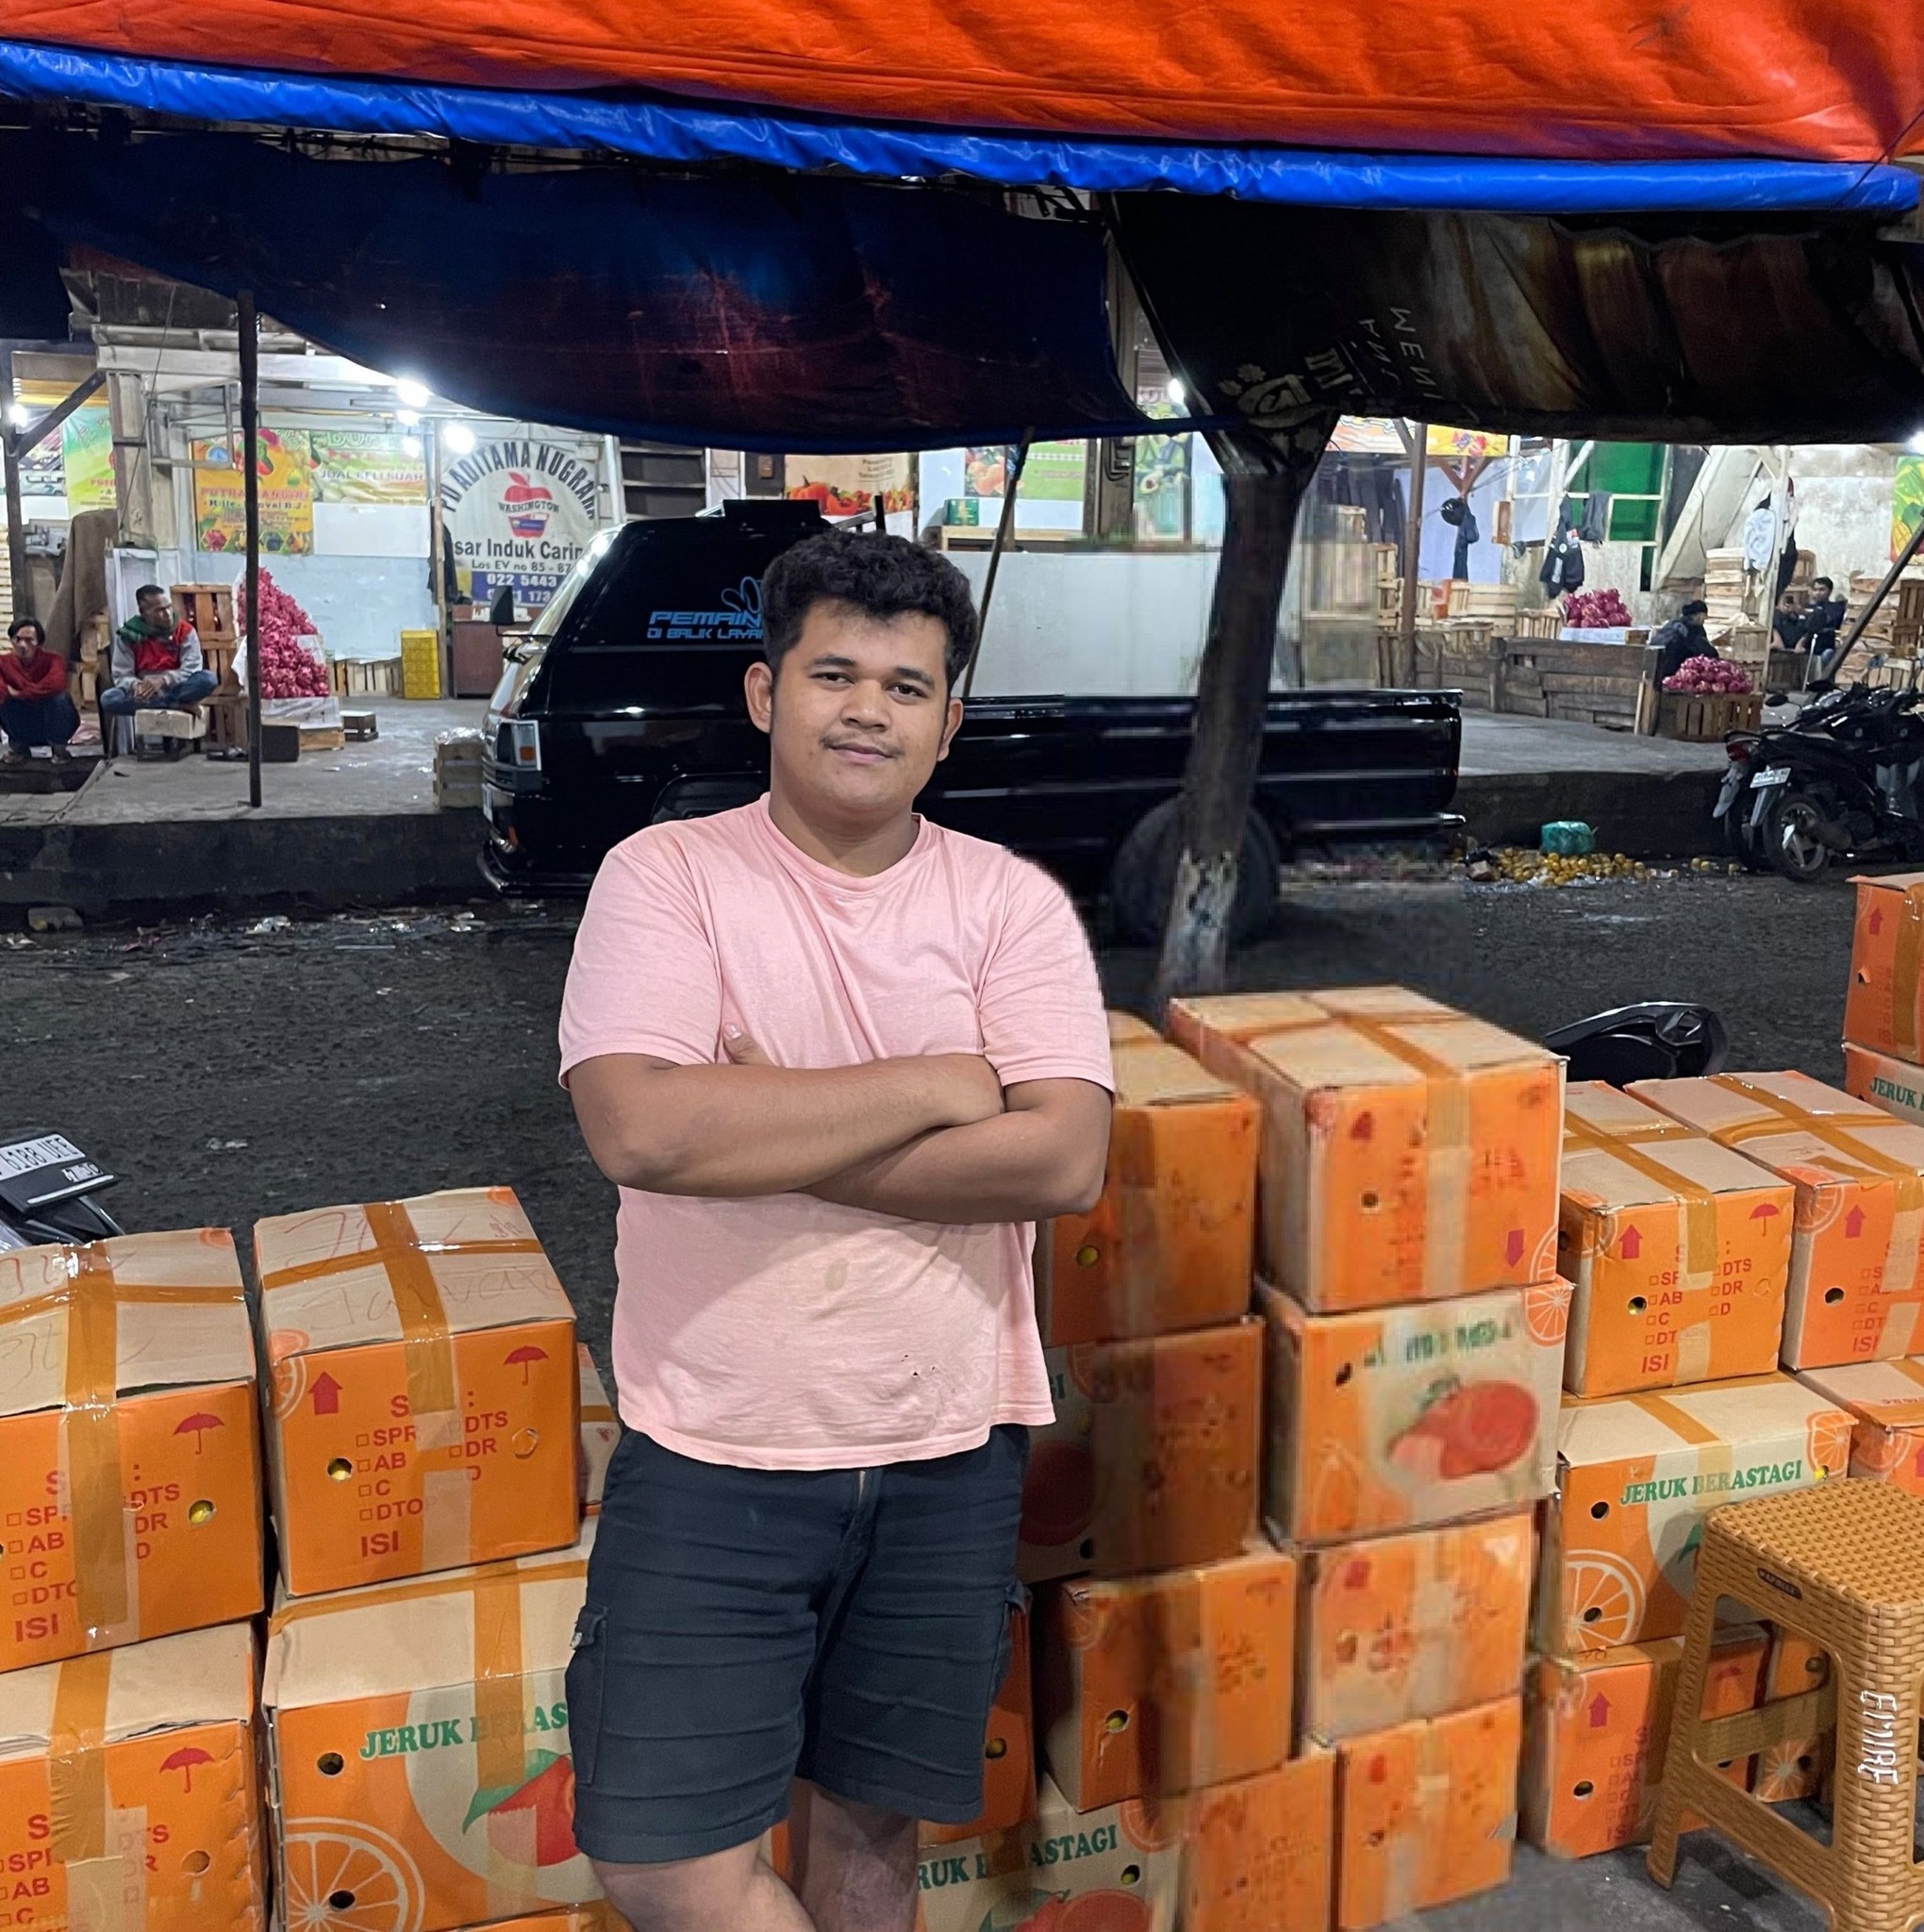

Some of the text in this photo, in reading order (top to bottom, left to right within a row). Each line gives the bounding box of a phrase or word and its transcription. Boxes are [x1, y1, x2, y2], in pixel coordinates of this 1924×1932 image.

[448, 441, 532, 491] ADITAMA
[498, 500, 560, 513] WASHINGTON
[455, 539, 584, 560] sar Induk Carin
[472, 558, 490, 570] Los
[495, 560, 510, 570] EV
[514, 563, 527, 572] no
[531, 561, 545, 572] 85
[487, 573, 557, 587] 022 5443
[647, 628, 662, 639] DI
[667, 628, 713, 639] BALIK
[1869, 1077, 1917, 1108] JERUK
[1723, 1258, 1751, 1275] DTS
[1660, 1280, 1743, 1306] AB DR
[1658, 1303, 1731, 1325] C D
[1656, 1330, 1678, 1345] DT
[1642, 1354, 1669, 1374] ISI
[465, 1411, 508, 1433] DTS
[374, 1439, 497, 1473] AB DR
[375, 1479, 391, 1496] C
[1620, 1460, 1802, 1505] JERUK BERASTAGI
[131, 1484, 180, 1508] DTS
[376, 1498, 423, 1521] DTO
[27, 1512, 169, 1554] AB DR
[361, 1530, 399, 1557] ISI
[30, 1542, 151, 1578] C D
[15, 1613, 58, 1642] ISI
[359, 1718, 463, 1758] JERUK
[918, 1855, 970, 1890] RUK
[12, 1877, 50, 1901] AB
